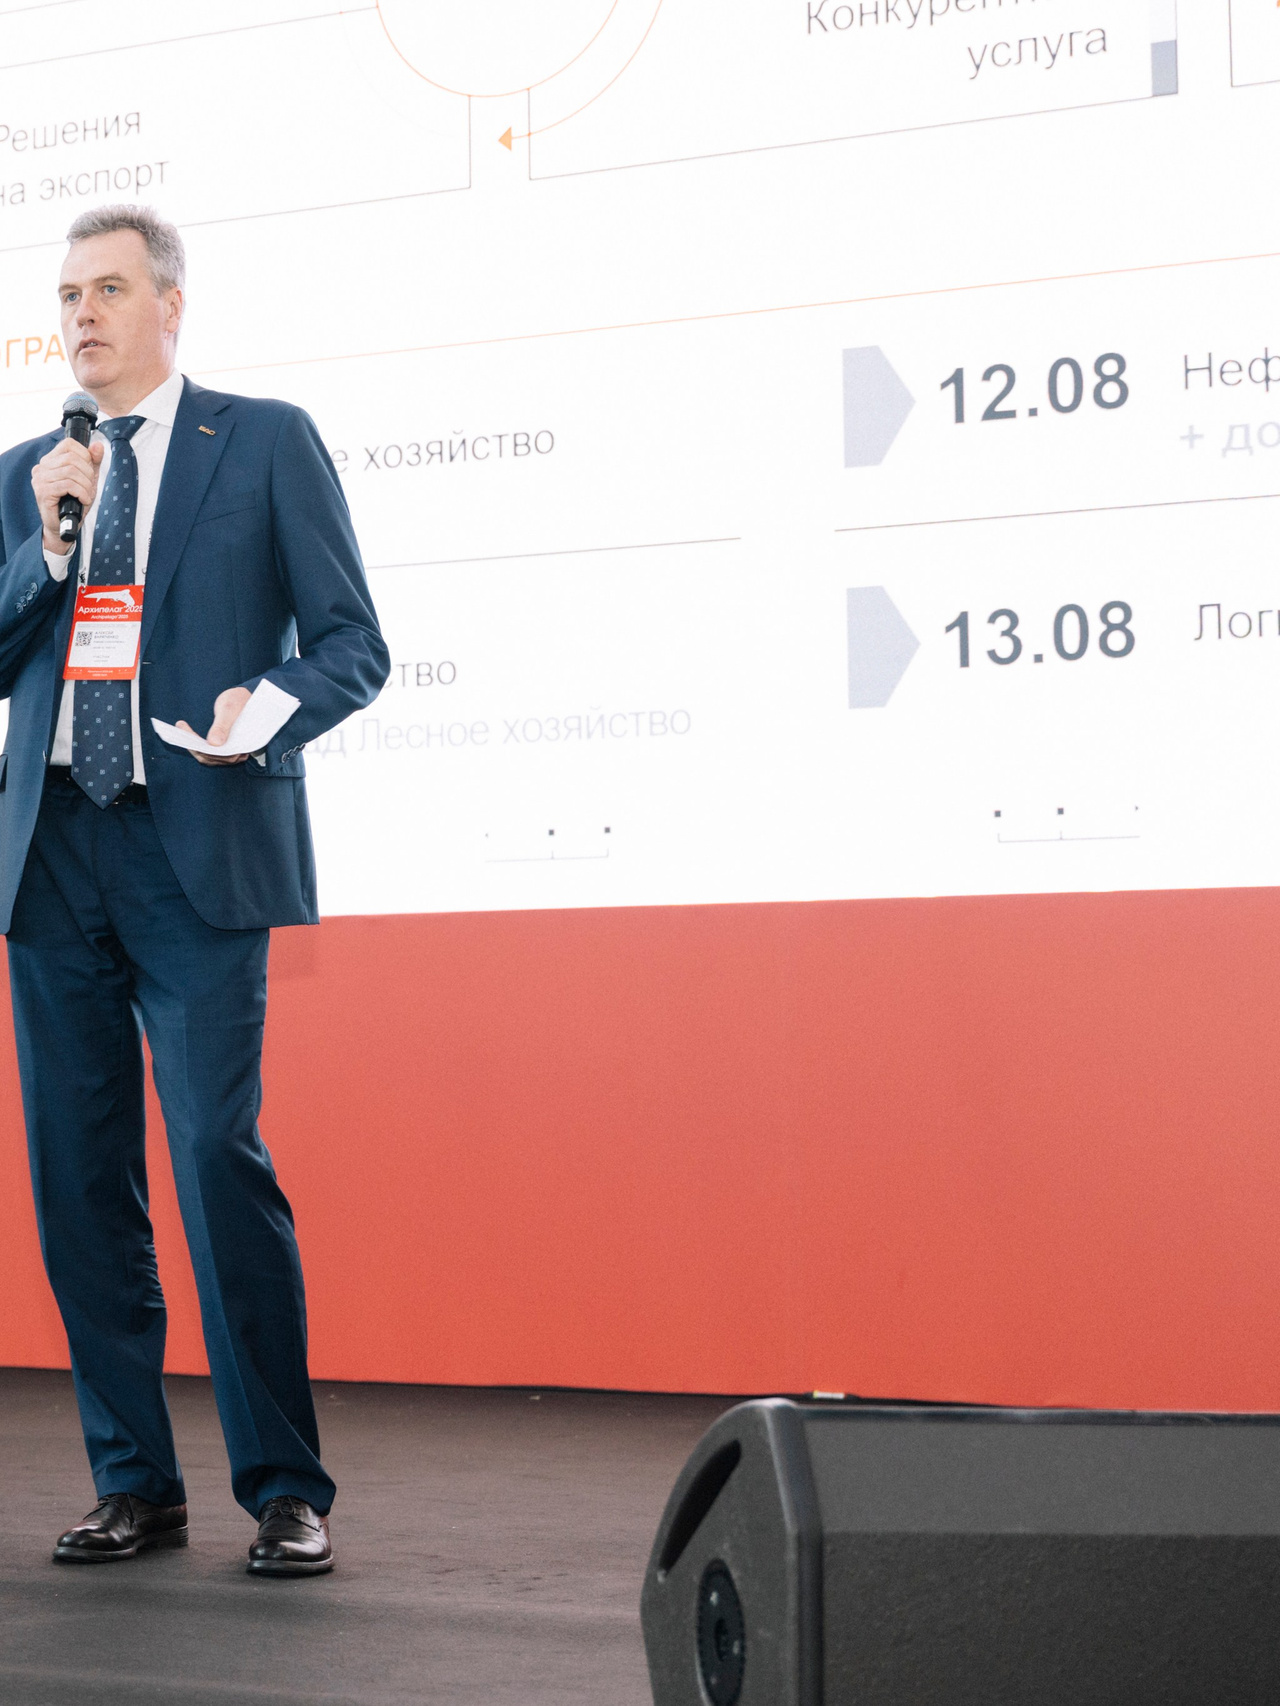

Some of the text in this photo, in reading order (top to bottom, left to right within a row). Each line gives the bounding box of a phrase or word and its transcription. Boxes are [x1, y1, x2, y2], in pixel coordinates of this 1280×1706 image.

[967, 27, 1107, 80] услуга
[39, 160, 170, 196] экспорт
[939, 352, 1130, 425] 12.08
[363, 429, 555, 471] хозяйство
[944, 600, 1280, 668] 13.08 Лог
[384, 660, 457, 688] тво
[357, 718, 490, 752] Лесное
[502, 704, 692, 745] хозяйство
